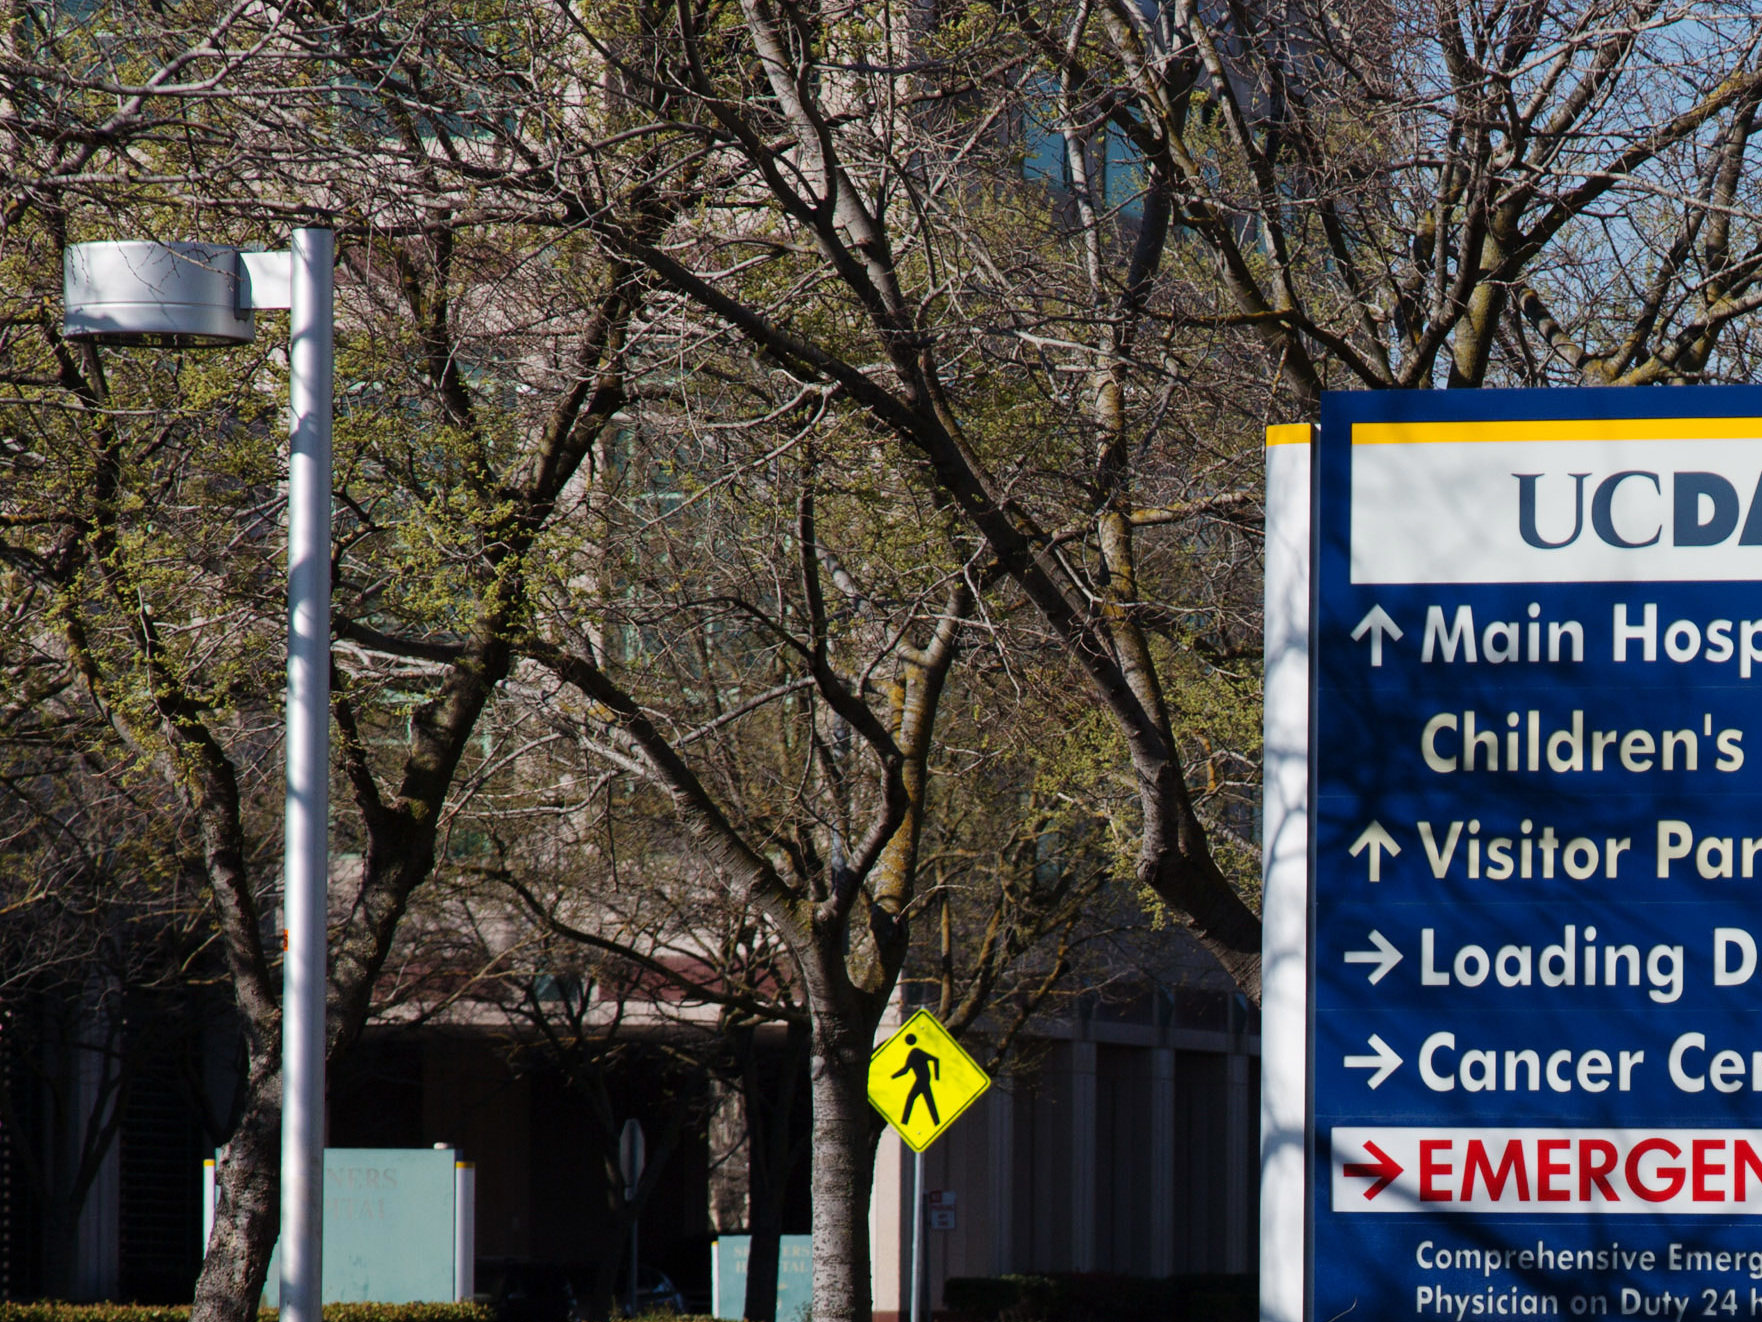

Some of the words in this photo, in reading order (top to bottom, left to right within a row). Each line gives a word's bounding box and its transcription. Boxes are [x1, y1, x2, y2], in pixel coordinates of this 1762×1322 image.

[1421, 602, 1584, 664] Main
[1421, 709, 1745, 774] Children's
[1417, 819, 1631, 881] Visitor
[1421, 924, 1684, 1004] Loading
[1418, 1031, 1645, 1093] Cancer
[1416, 1240, 1656, 1277] Comprehensive
[1416, 1284, 1558, 1322] Physician
[1570, 1295, 1608, 1316] on
[1701, 1288, 1738, 1316] 24
